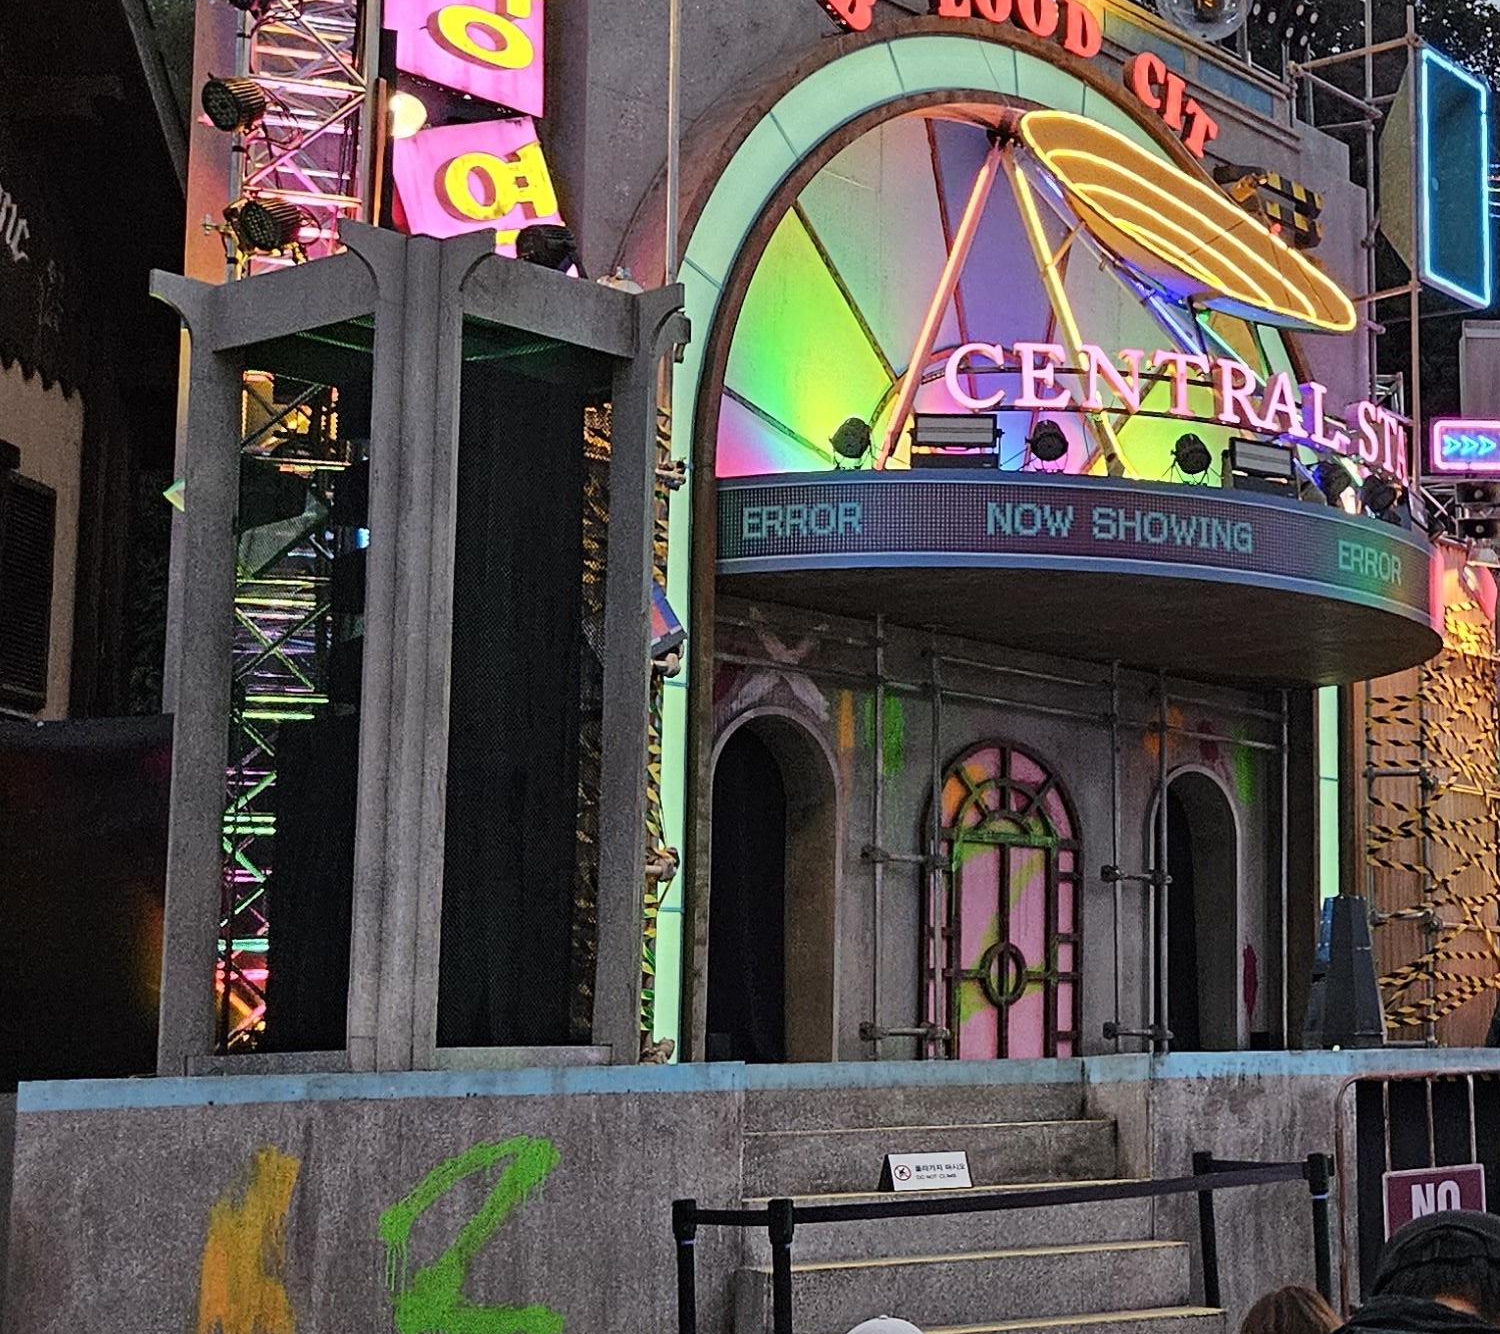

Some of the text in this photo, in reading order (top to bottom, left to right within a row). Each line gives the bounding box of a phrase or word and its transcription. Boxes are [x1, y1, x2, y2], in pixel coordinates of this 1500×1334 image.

[944, 342, 1351, 455] CENTRAL
[743, 502, 862, 540] ERROR
[986, 502, 1253, 554] NOW SHOWING
[1337, 539, 1402, 586] ERROR
[1411, 1180, 1461, 1219] NO
